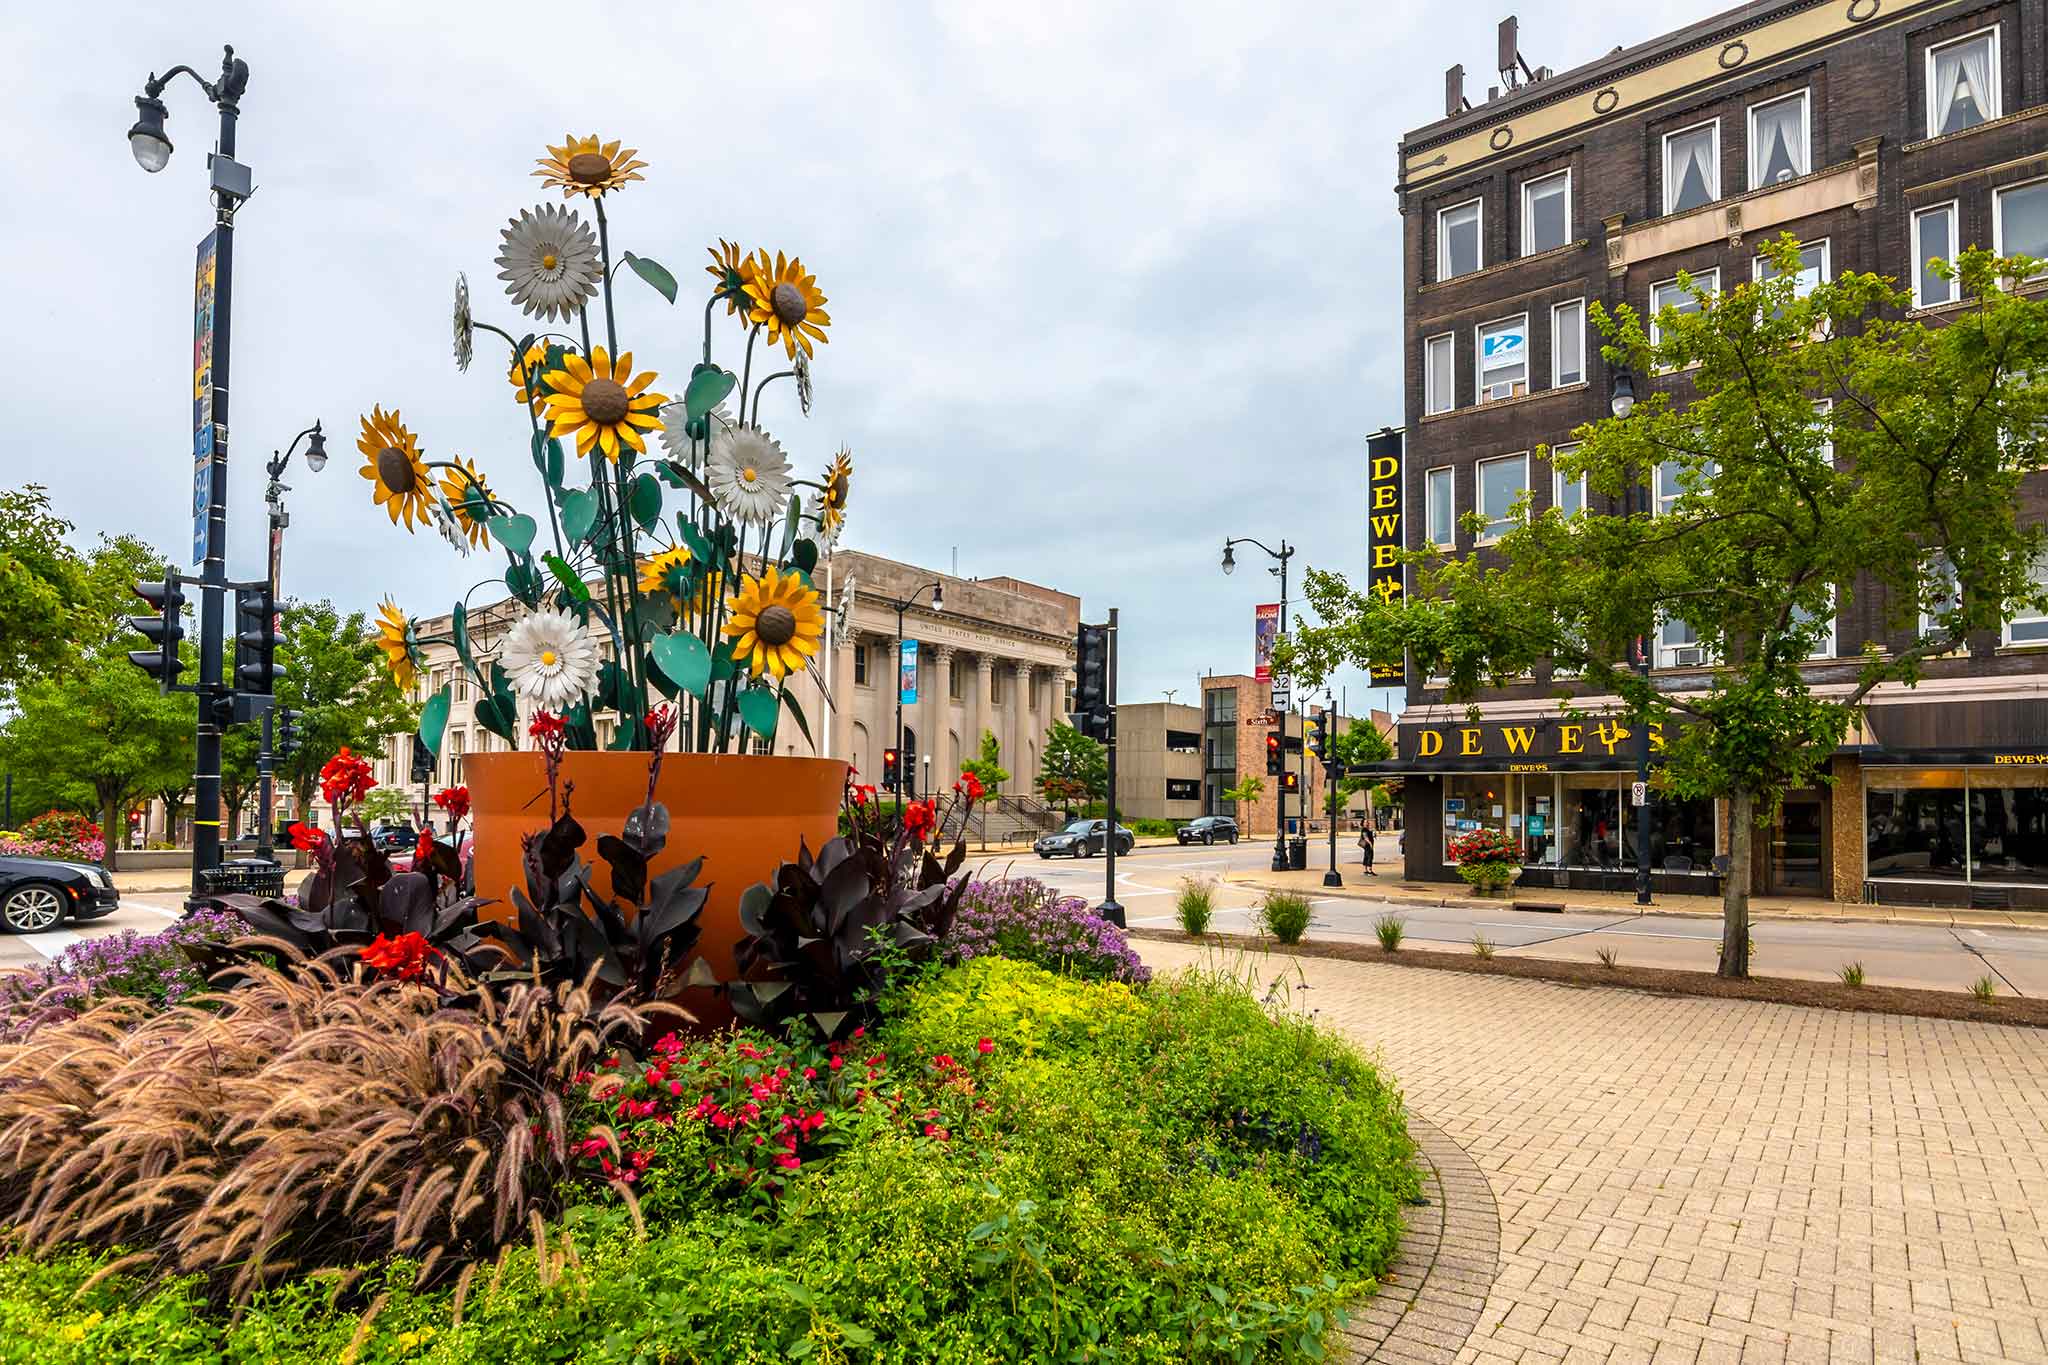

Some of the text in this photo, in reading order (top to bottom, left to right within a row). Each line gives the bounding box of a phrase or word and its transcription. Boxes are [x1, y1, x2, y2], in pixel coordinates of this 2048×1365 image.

[194, 469, 208, 500] 94
[1370, 456, 1402, 606] DEWEY
[920, 624, 943, 633] UNITED
[948, 629, 970, 638] STATES
[994, 639, 1015, 647] OFFICE
[1273, 677, 1289, 689] 32
[1371, 671, 1391, 679] Sports
